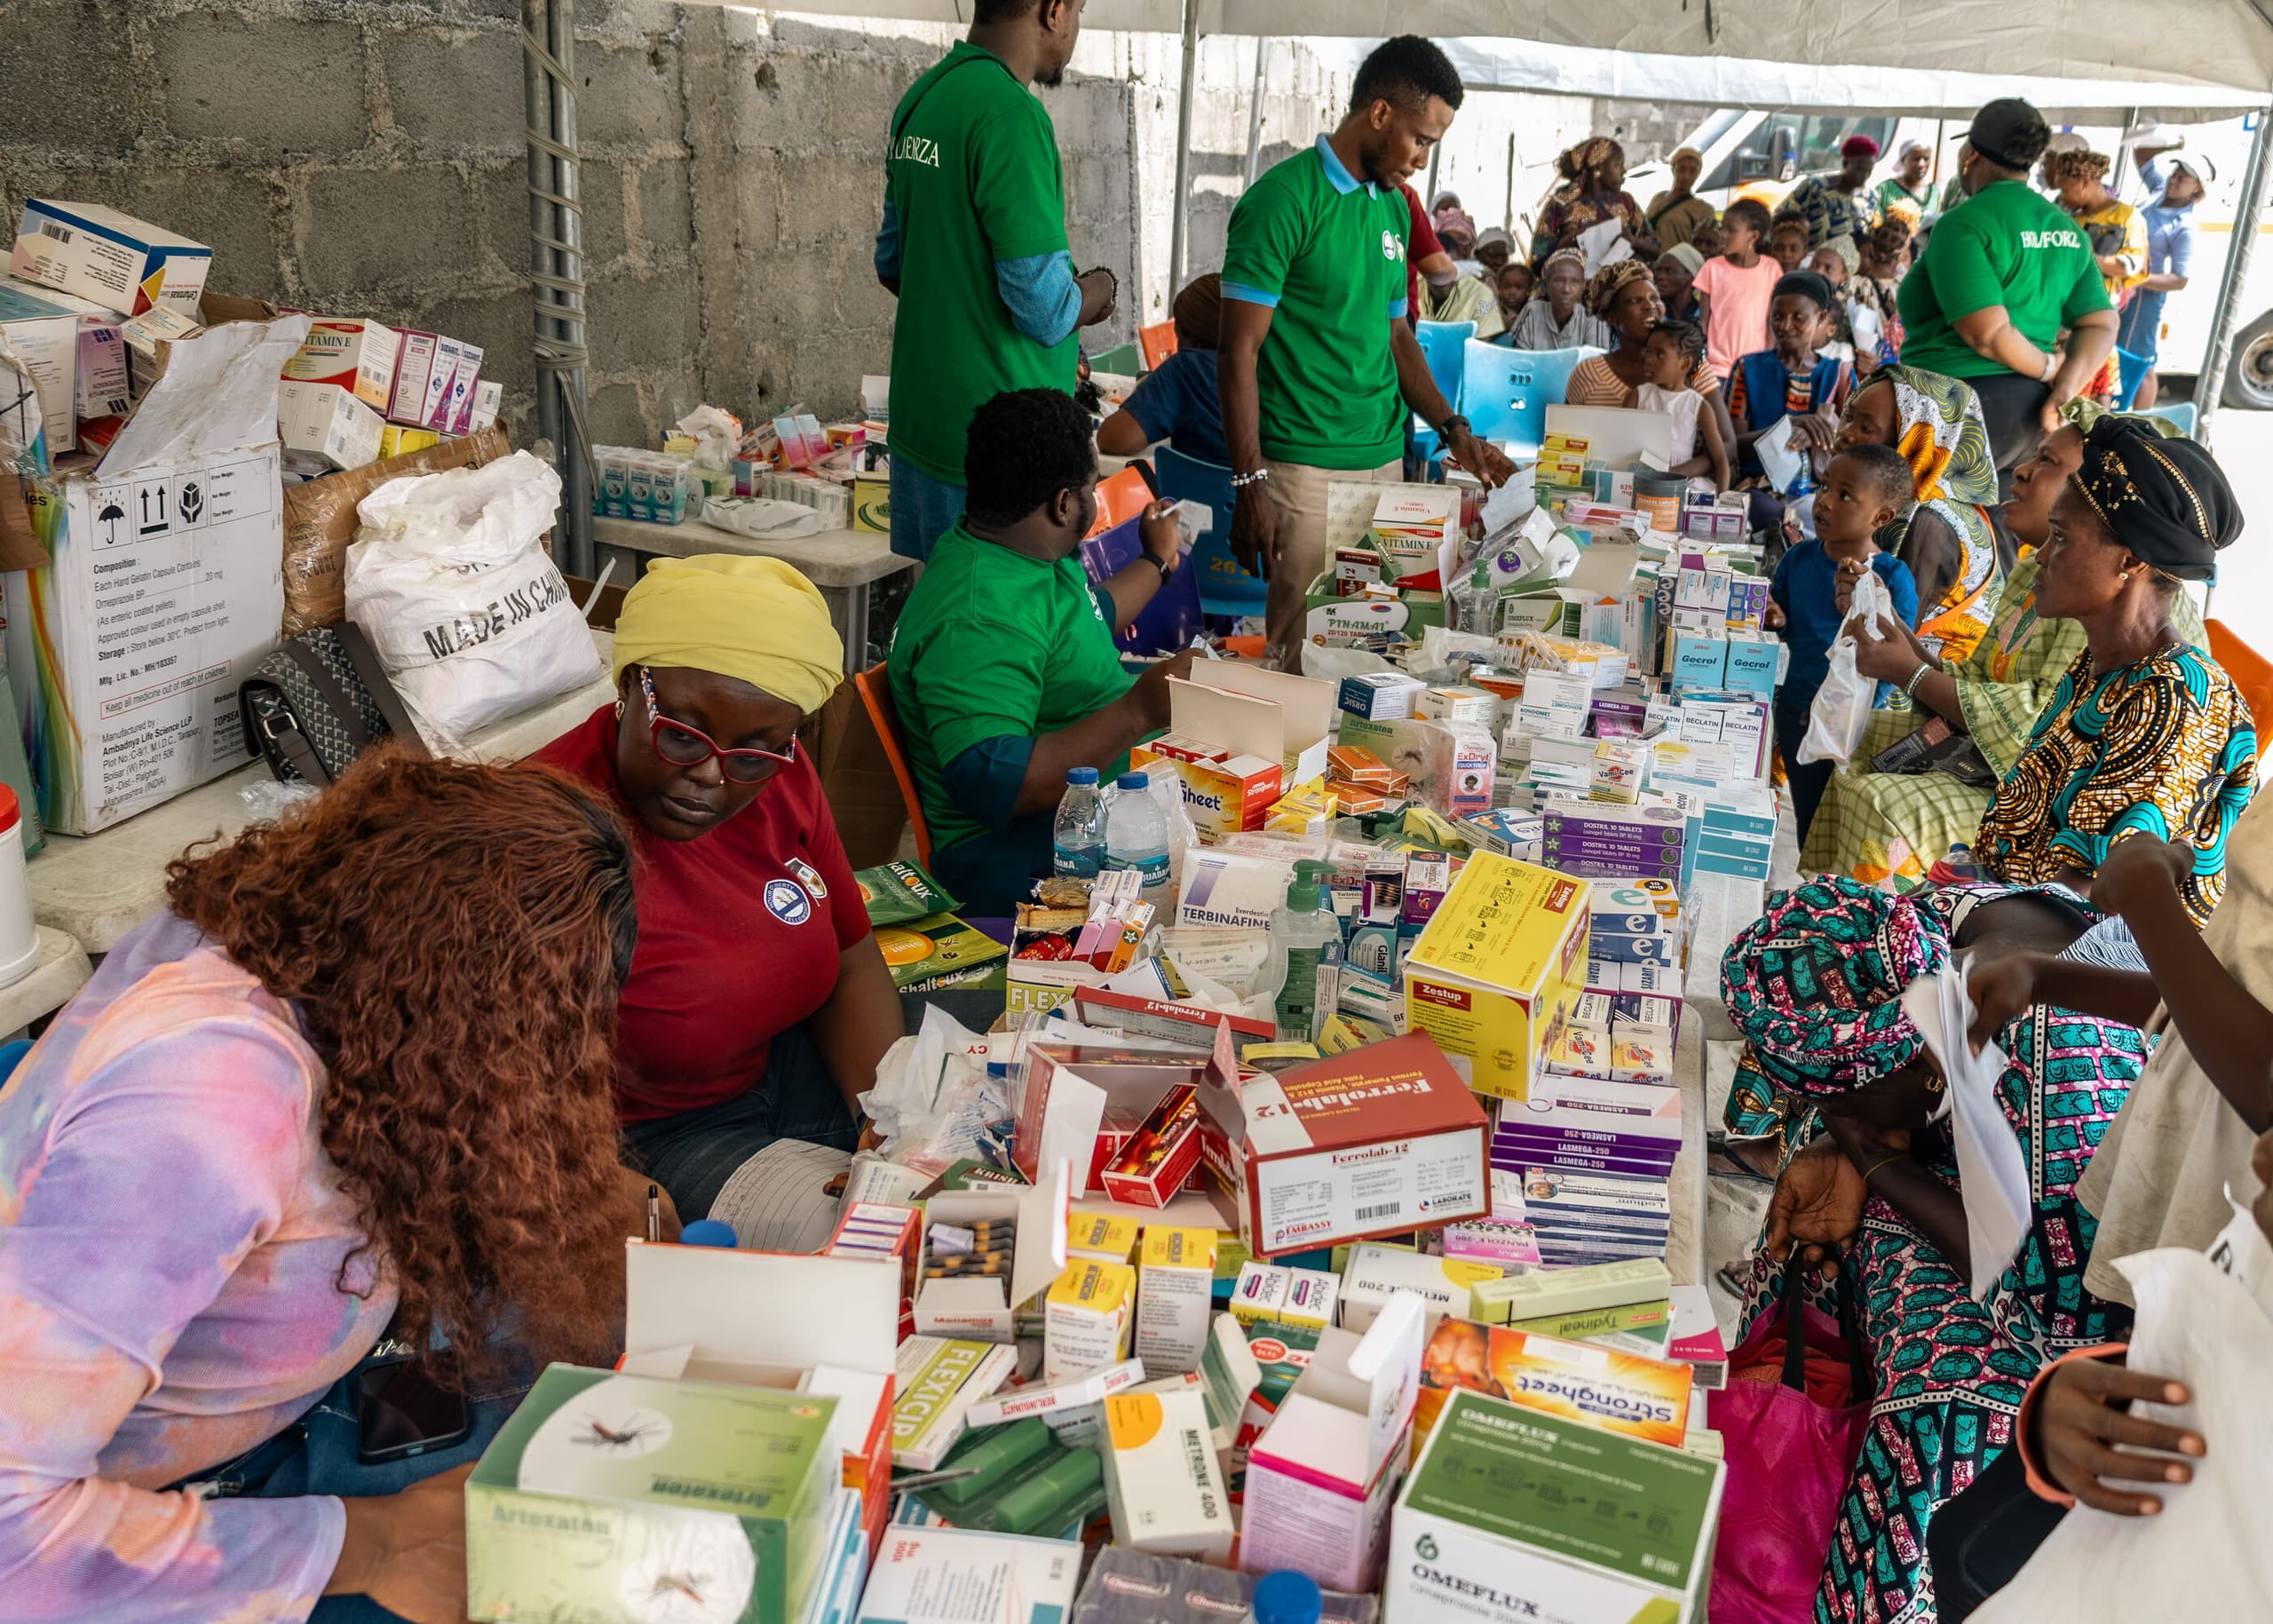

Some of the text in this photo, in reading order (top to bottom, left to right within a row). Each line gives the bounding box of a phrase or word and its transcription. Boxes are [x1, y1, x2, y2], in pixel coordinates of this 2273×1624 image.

[1382, 538, 1432, 551] VITAMIN E
[93, 558, 136, 575] Composition
[94, 581, 113, 592] Each
[114, 578, 131, 589] Hard
[131, 572, 152, 585] Gelatin
[153, 566, 176, 580] Capsule
[95, 570, 223, 610] Omeprazole BP 20 mg
[97, 598, 176, 627] (As enteric coated pellets)
[98, 627, 130, 644] Approved
[131, 622, 150, 636] colour
[151, 619, 166, 630] used
[172, 611, 190, 624] empty
[191, 606, 212, 620] capsule
[423, 602, 504, 660] MADE
[503, 589, 533, 626] IN
[99, 646, 126, 661] Storage
[131, 639, 147, 653] Store
[147, 635, 166, 647] below
[183, 622, 203, 637] Protect
[203, 619, 218, 630] from
[1682, 654, 1718, 666] Gecrol
[1733, 658, 1770, 669] Gecrol
[99, 676, 114, 686] Mfg.
[116, 671, 129, 682] Lic.
[105, 701, 123, 714] Keep
[133, 689, 162, 705] medicine
[162, 685, 172, 696] out
[172, 682, 180, 693] of
[179, 676, 197, 690] reach
[197, 674, 204, 684] of
[1344, 695, 1367, 711] ORSIC
[1598, 701, 1630, 711] LASMEGA-250
[1519, 708, 1551, 717] BONDOMET
[1647, 712, 1681, 724] BECLATIN
[1685, 717, 1719, 728] BECLATIN
[1725, 721, 1759, 733] BECLATIN
[102, 719, 156, 744] Manufactured by
[102, 716, 194, 757] Ambadnya Life Science LLP
[102, 757, 117, 769] Plot
[1457, 752, 1491, 764] ExDryl
[125, 764, 139, 777] (W)
[144, 775, 167, 792] (INDIA)
[1583, 821, 1609, 830] DOSTRIL
[1618, 825, 1643, 834] TABLETS
[1582, 840, 1608, 849] DOSTRIL
[1617, 844, 1642, 853] TABLETS
[1580, 860, 1606, 868] DOSTRIL
[1615, 863, 1640, 872] TABLETS
[1556, 885, 1573, 908] Zestup
[1183, 907, 1271, 931] TERBINAFINE
[1377, 944, 1389, 973] Glanil
[1422, 984, 1462, 1002] Zestup
[1146, 1001, 1207, 1020] Ferrolab-12
[1284, 1073, 1364, 1092] Folic Acid Capsules
[1396, 1070, 1423, 1081] Ferrous
[1317, 1081, 1348, 1092] Vitamin
[1255, 1078, 1434, 1119] Ferrolab-12
[1566, 1101, 1630, 1113] LASMEGA-250
[1564, 1129, 1617, 1143] LASMEGA-250
[1332, 1142, 1410, 1165] Ferrolab-12
[1557, 1143, 1610, 1156] LASMEGA-250
[1554, 1155, 1605, 1169] LASMEGA-250
[1431, 1192, 1472, 1206] LABORATE
[1286, 1219, 1333, 1235] EMBASSY
[1258, 1271, 1282, 1303] Abidec
[1308, 1276, 1330, 1311] Abidec
[1358, 1278, 1384, 1294] 200
[1558, 1314, 1620, 1335] Tydineal
[892, 1347, 977, 1437] FLEXICIP
[1515, 1375, 1675, 1423] Strongheet
[1461, 1407, 1560, 1444] OMEFLUX
[1185, 1428, 1218, 1519] METRONE 400
[1412, 1562, 1541, 1619] OMEFLUX
